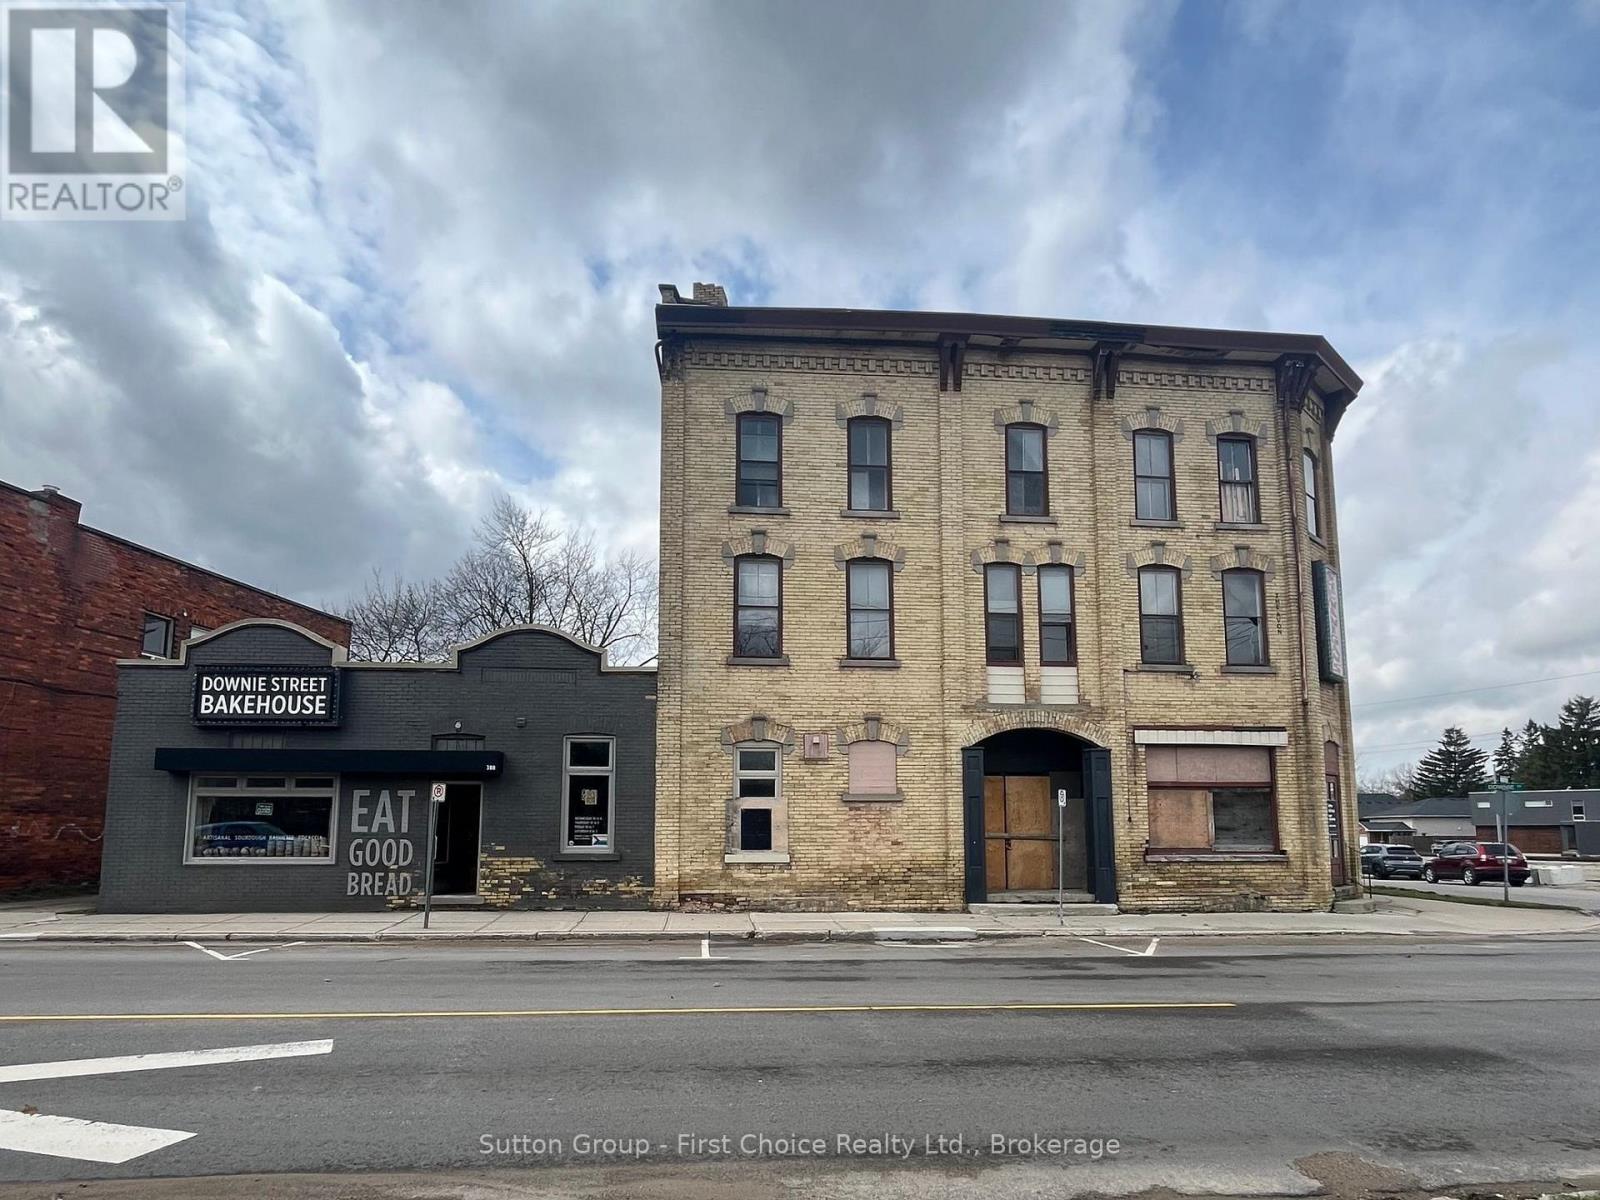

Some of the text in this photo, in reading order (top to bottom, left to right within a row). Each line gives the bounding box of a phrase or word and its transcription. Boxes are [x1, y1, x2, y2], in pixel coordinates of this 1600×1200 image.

[202, 676, 327, 692] DOWNIE STREET
[200, 694, 327, 715] BAKEHOUSE
[351, 789, 416, 833] EAT
[349, 838, 413, 867] GOOD
[346, 872, 412, 896] BREAD
